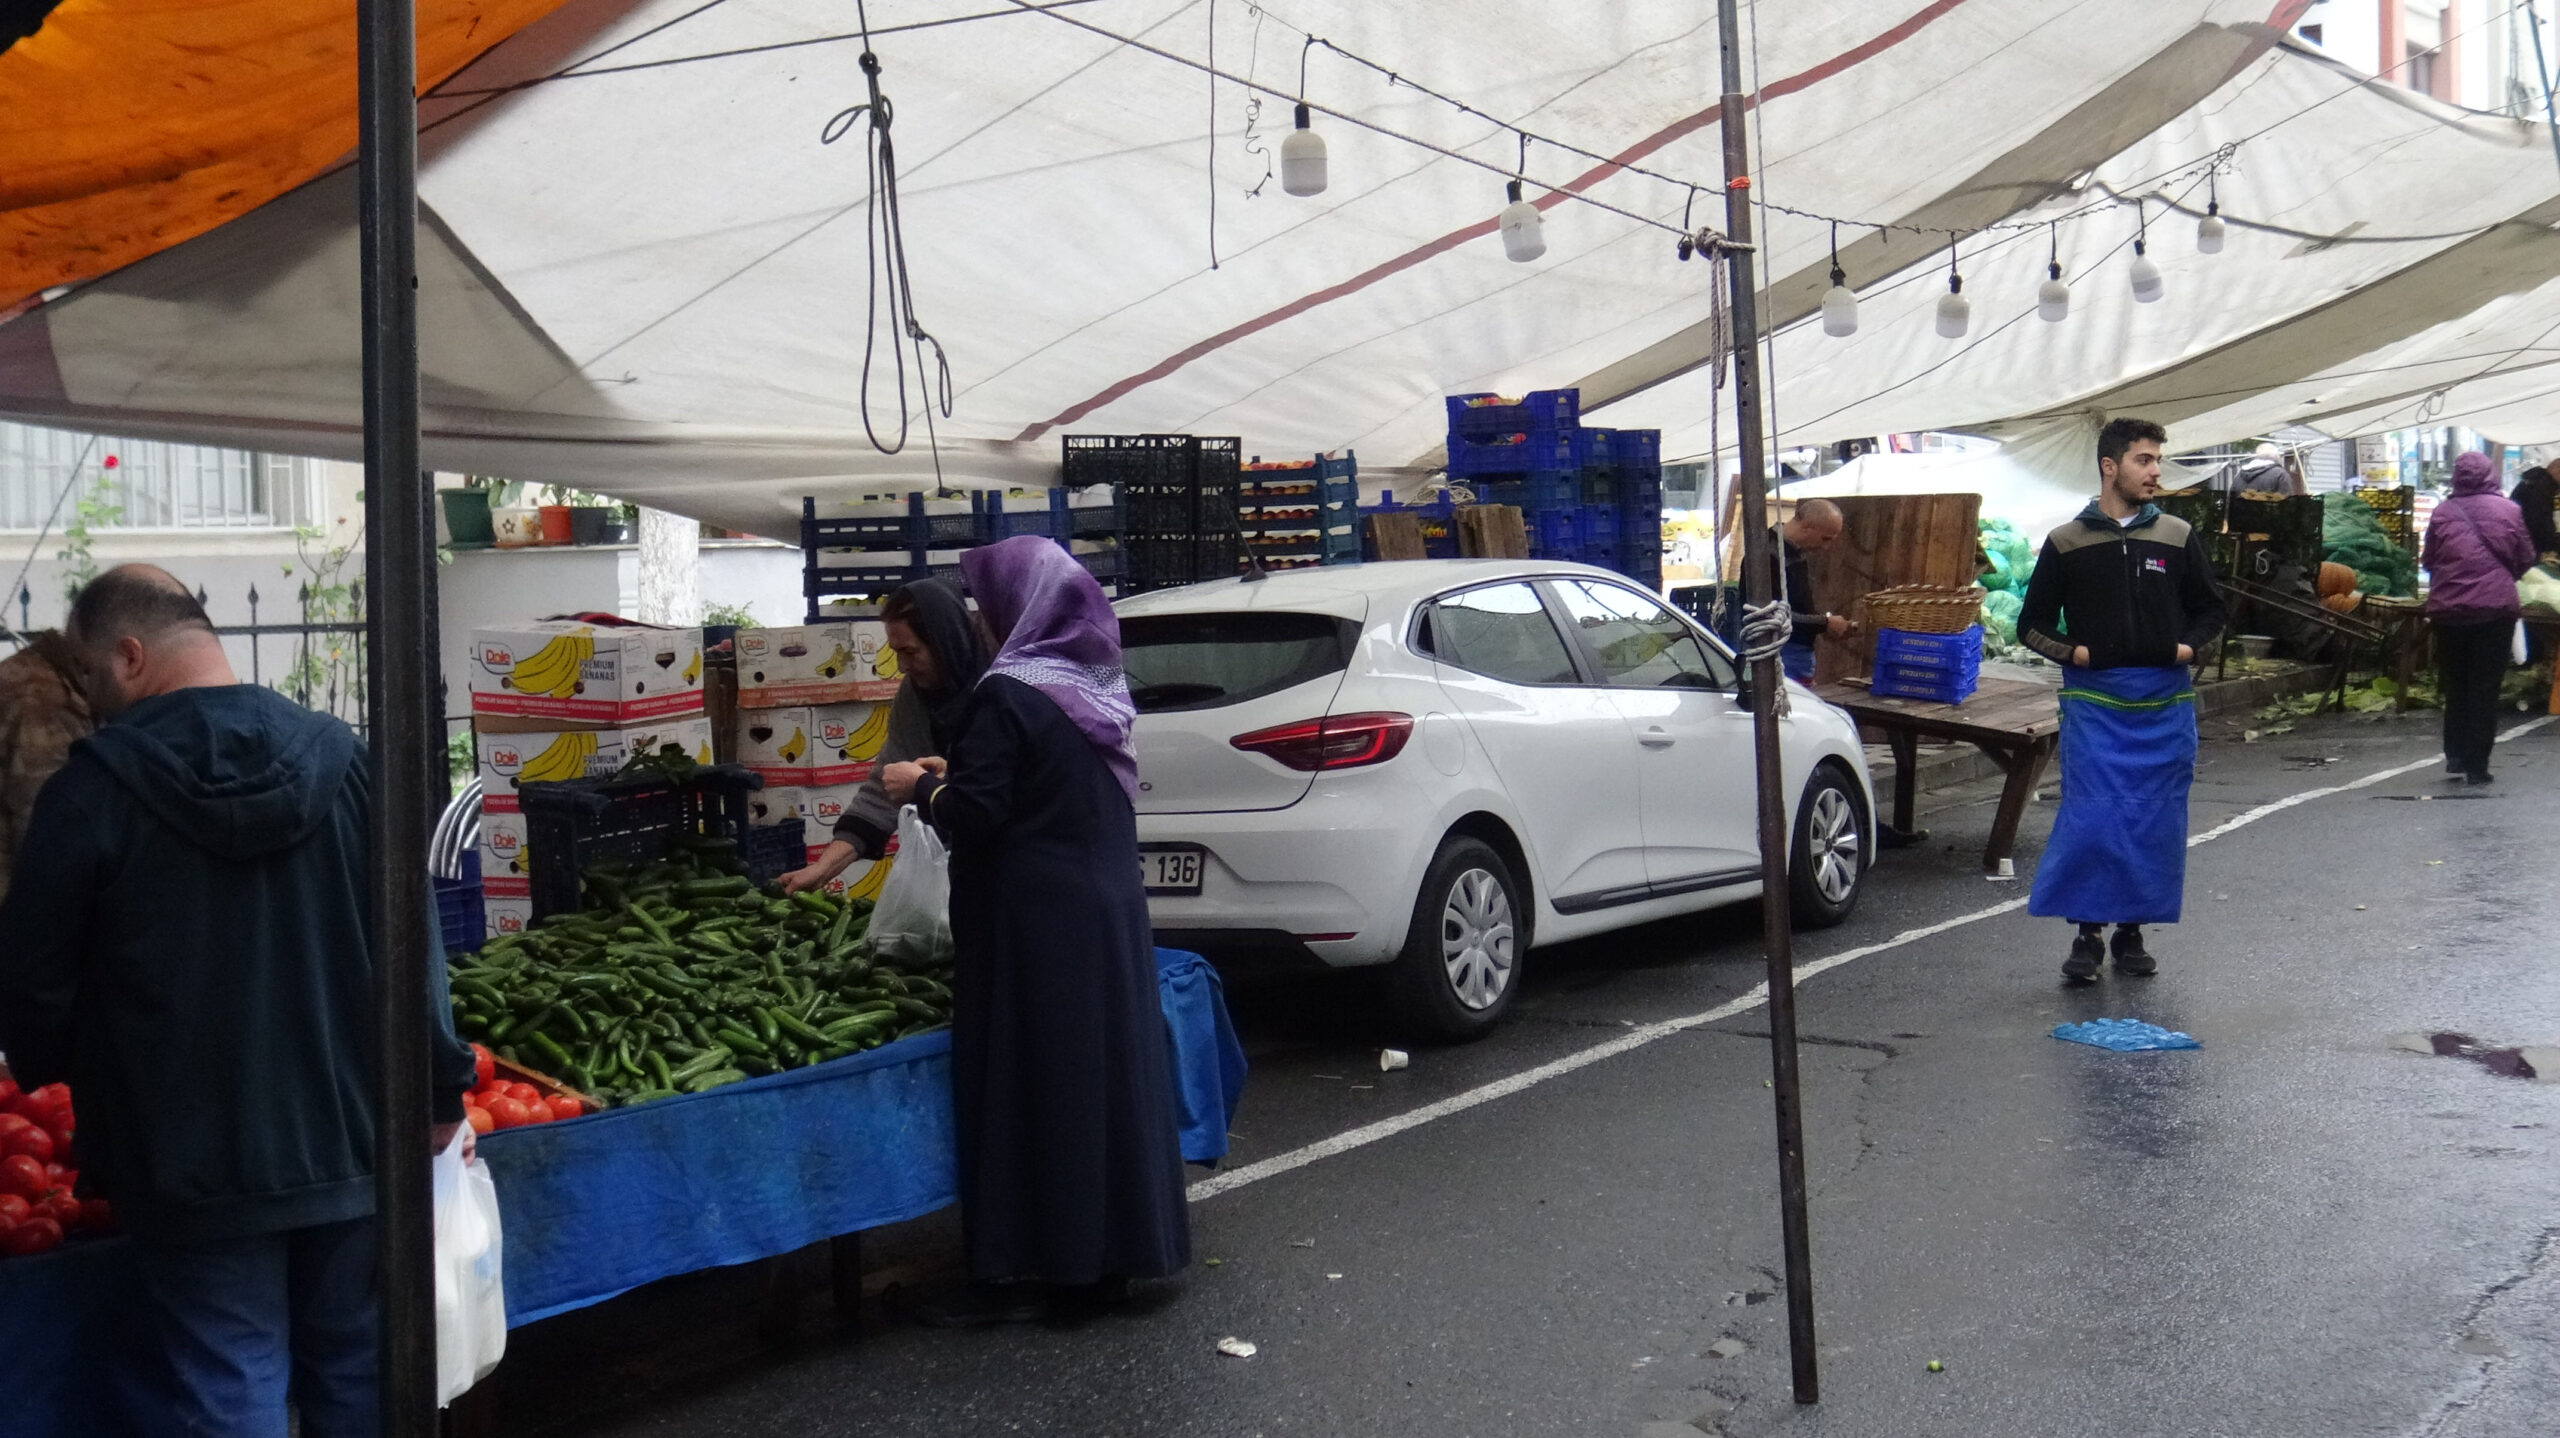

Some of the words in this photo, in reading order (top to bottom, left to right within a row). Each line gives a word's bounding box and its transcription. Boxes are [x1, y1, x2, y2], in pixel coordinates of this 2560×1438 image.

[486, 648, 510, 664] Dole
[580, 660, 614, 670] PREMIUM
[825, 724, 845, 737] Dole
[494, 751, 518, 764] Dole
[819, 802, 841, 815] Dole
[494, 834, 516, 847] Dole
[1158, 855, 1196, 883] 136
[826, 879, 844, 891] ole
[500, 916, 522, 930] Dole
